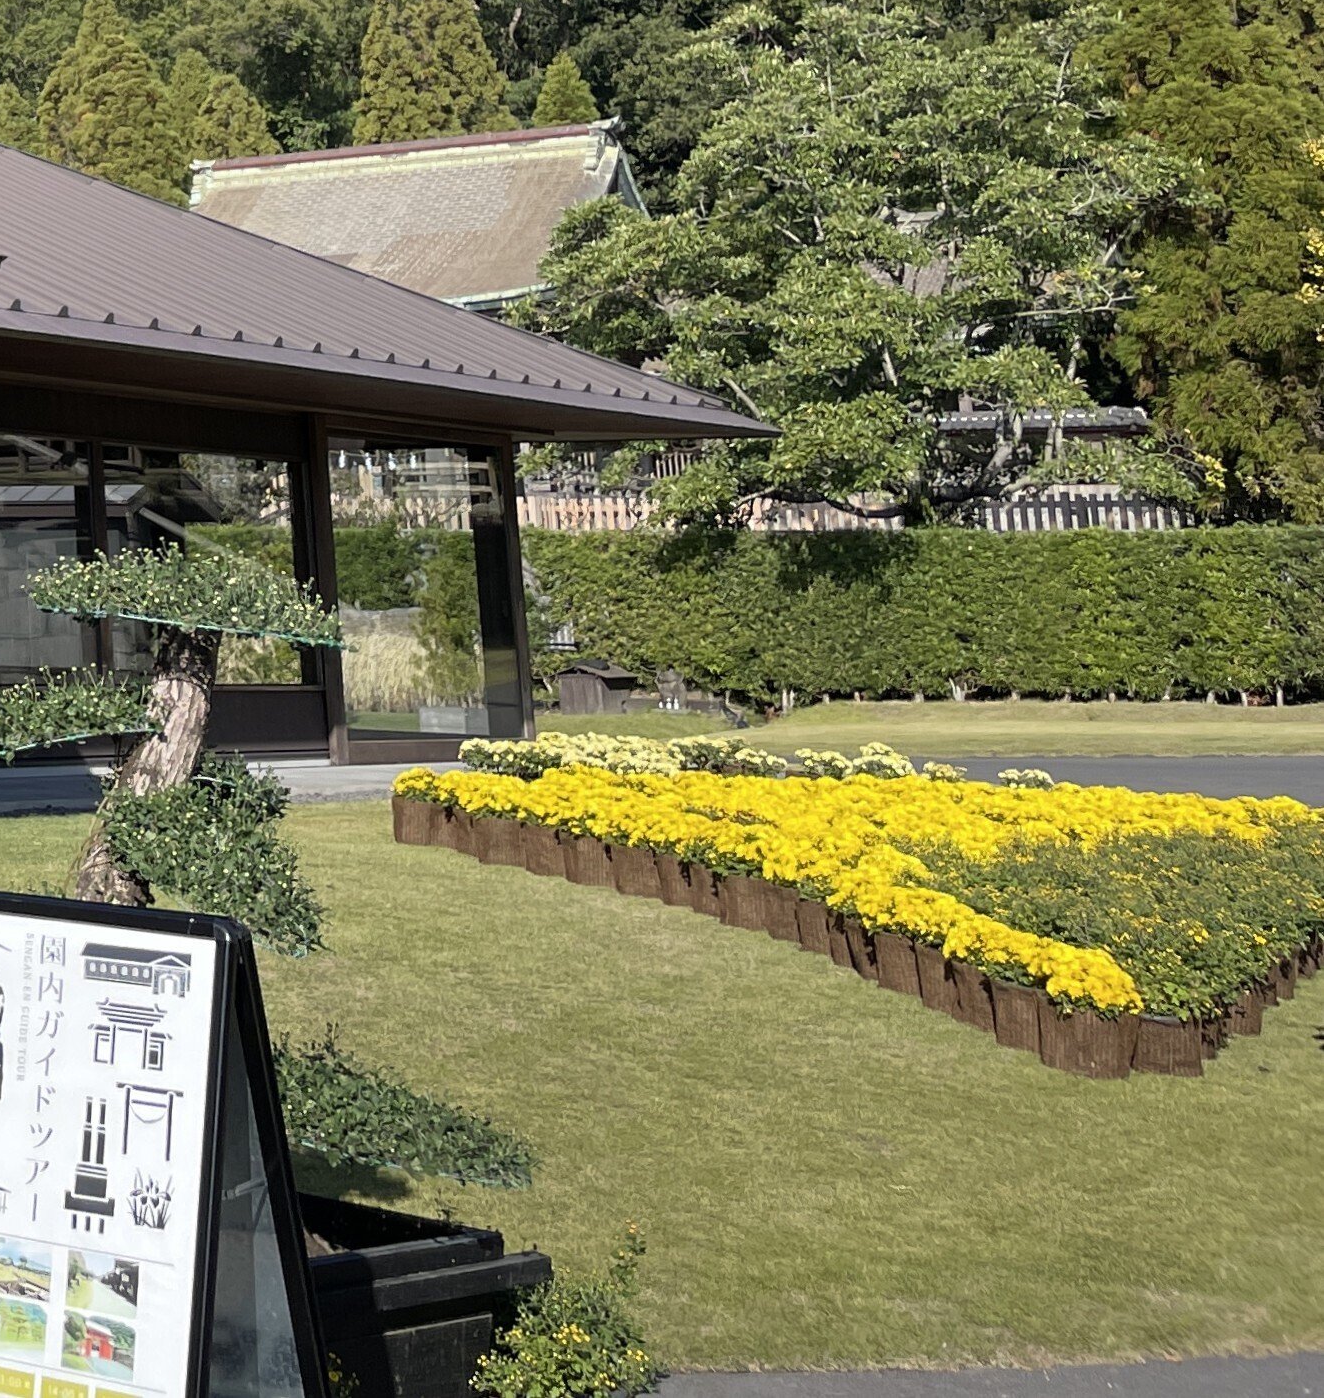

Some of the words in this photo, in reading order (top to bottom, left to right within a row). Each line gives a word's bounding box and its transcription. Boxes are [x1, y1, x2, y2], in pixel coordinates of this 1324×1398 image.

[18, 1006, 30, 1044] GUIDE
[16, 1049, 27, 1082] TOUR
[26, 934, 67, 1222] 園内ガイドツアー
